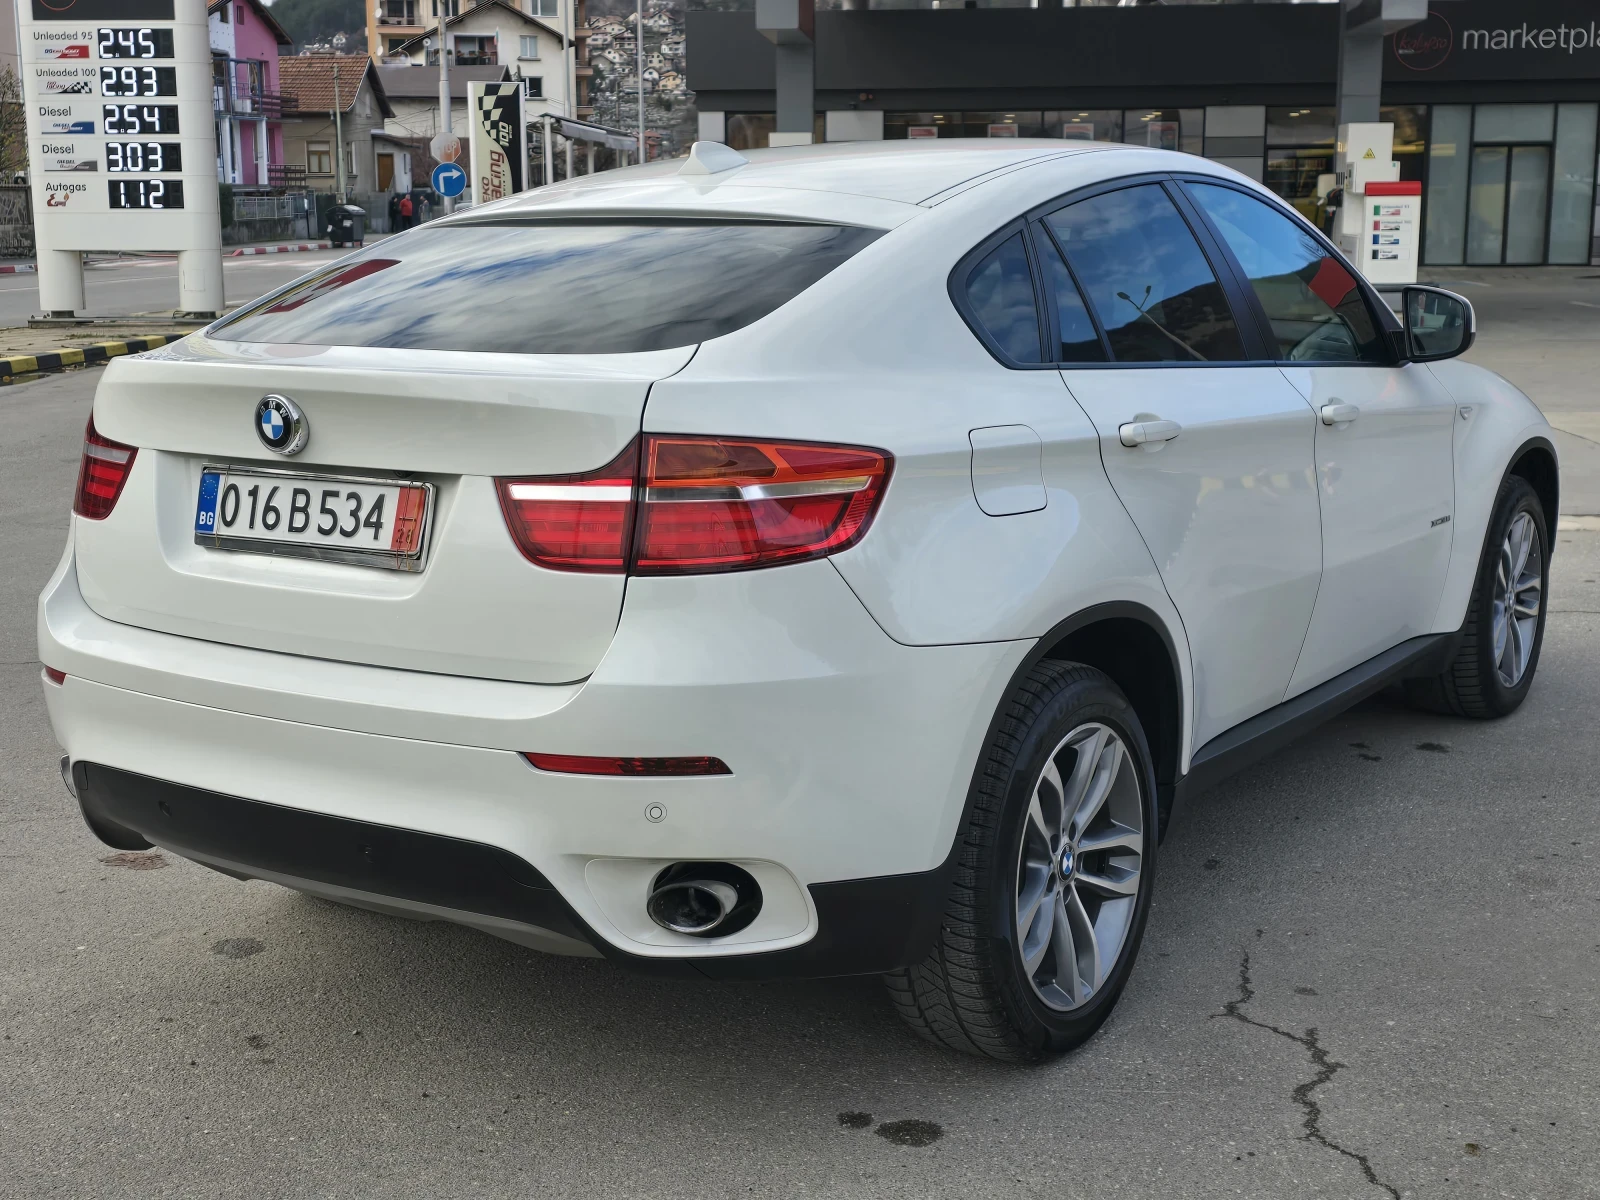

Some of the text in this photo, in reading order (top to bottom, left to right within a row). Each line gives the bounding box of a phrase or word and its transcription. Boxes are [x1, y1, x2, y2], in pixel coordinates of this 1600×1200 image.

[33, 31, 93, 40] Unleaded 95
[1462, 21, 1600, 54] marketpl
[36, 68, 96, 77] Unleaded 100
[39, 106, 72, 116] Diesel
[499, 121, 510, 147] 100
[42, 144, 74, 154] Diesel
[45, 182, 87, 193] Autogas
[260, 400, 291, 418] BMW
[199, 511, 214, 525] BG
